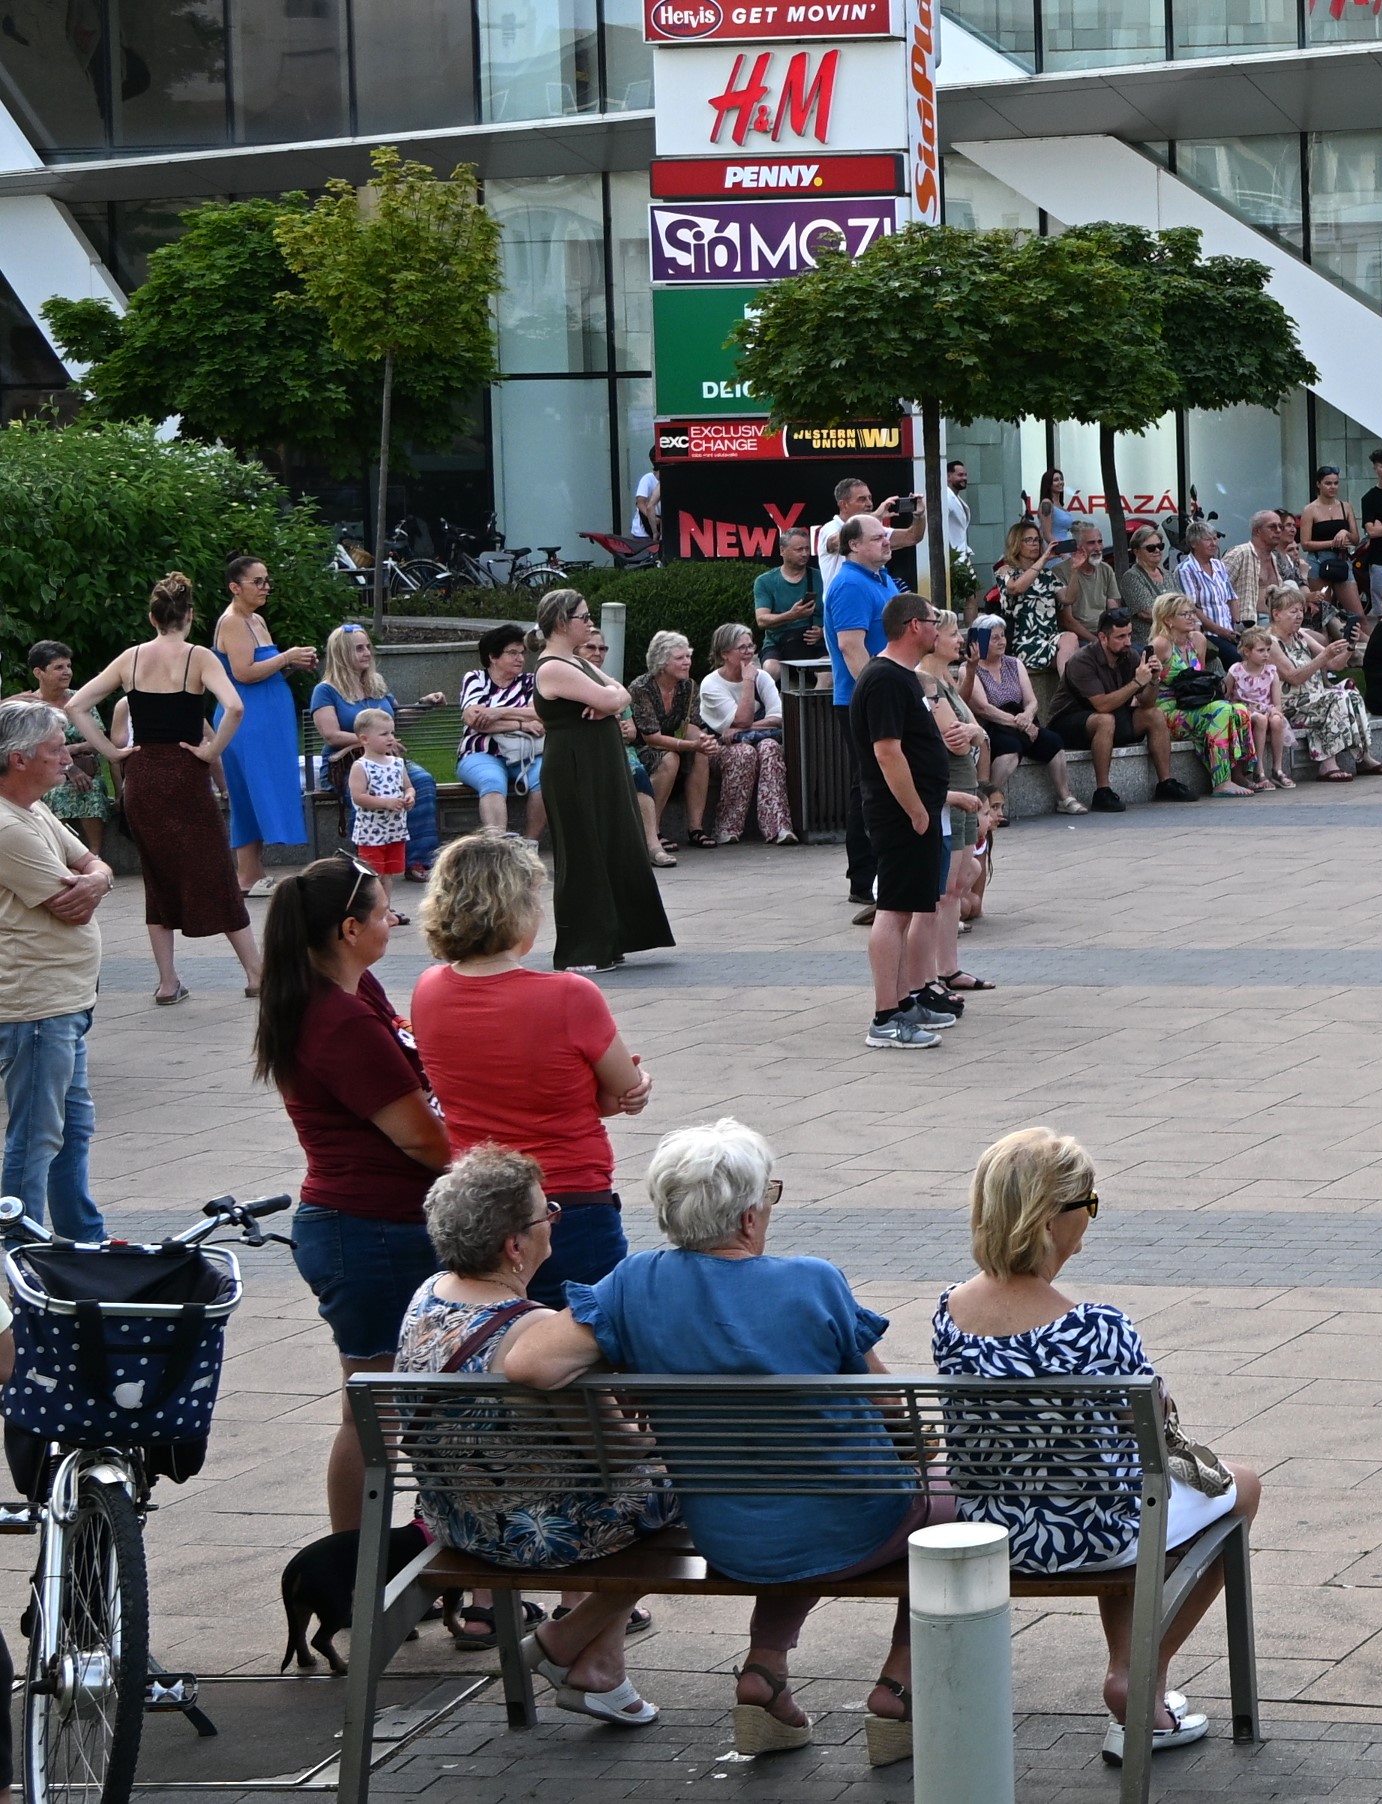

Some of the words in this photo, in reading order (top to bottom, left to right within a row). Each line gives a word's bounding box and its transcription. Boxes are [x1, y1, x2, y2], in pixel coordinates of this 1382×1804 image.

[660, 6, 716, 28] Hervis
[732, 7, 777, 25] GET
[708, 49, 841, 146] H&M
[690, 425, 766, 438] EXCLUSIV
[660, 436, 689, 449] exc
[691, 439, 758, 452] CHANGE
[812, 438, 856, 449] UNION
